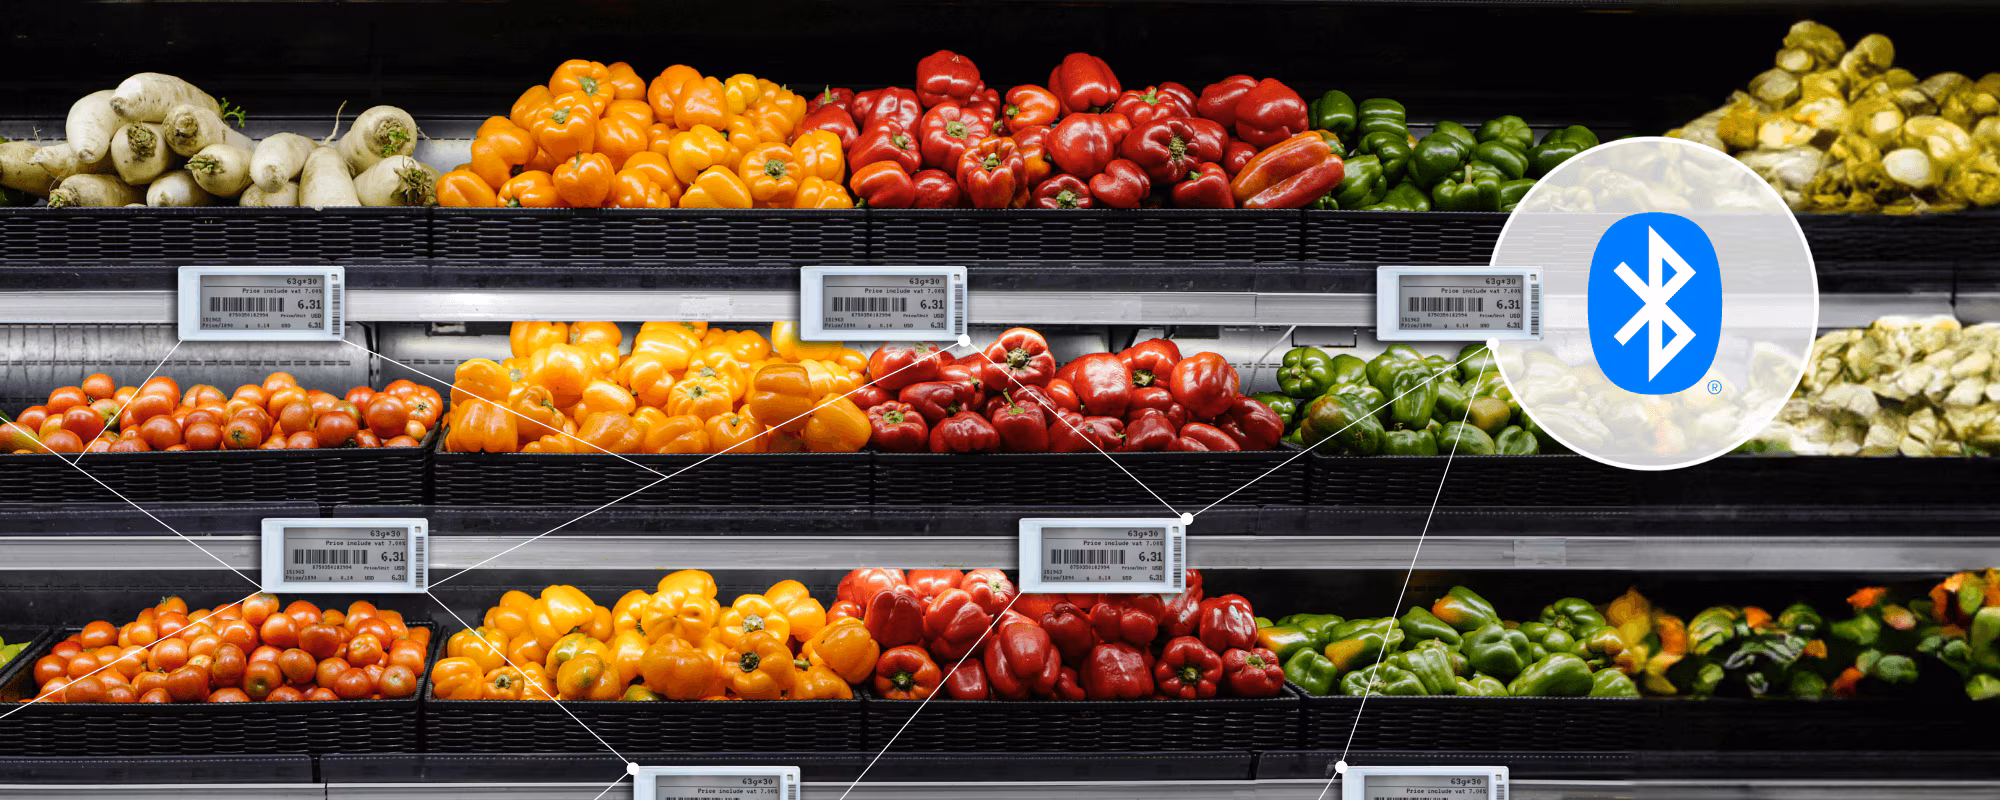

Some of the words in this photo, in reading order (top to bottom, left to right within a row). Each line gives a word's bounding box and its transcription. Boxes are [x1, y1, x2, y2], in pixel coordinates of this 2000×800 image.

[298, 300, 321, 310] 6.31
[920, 300, 944, 310] 6.31
[1496, 300, 1520, 310] 6.31
[381, 552, 405, 562] 6.31
[1139, 552, 1162, 562] 6.31
